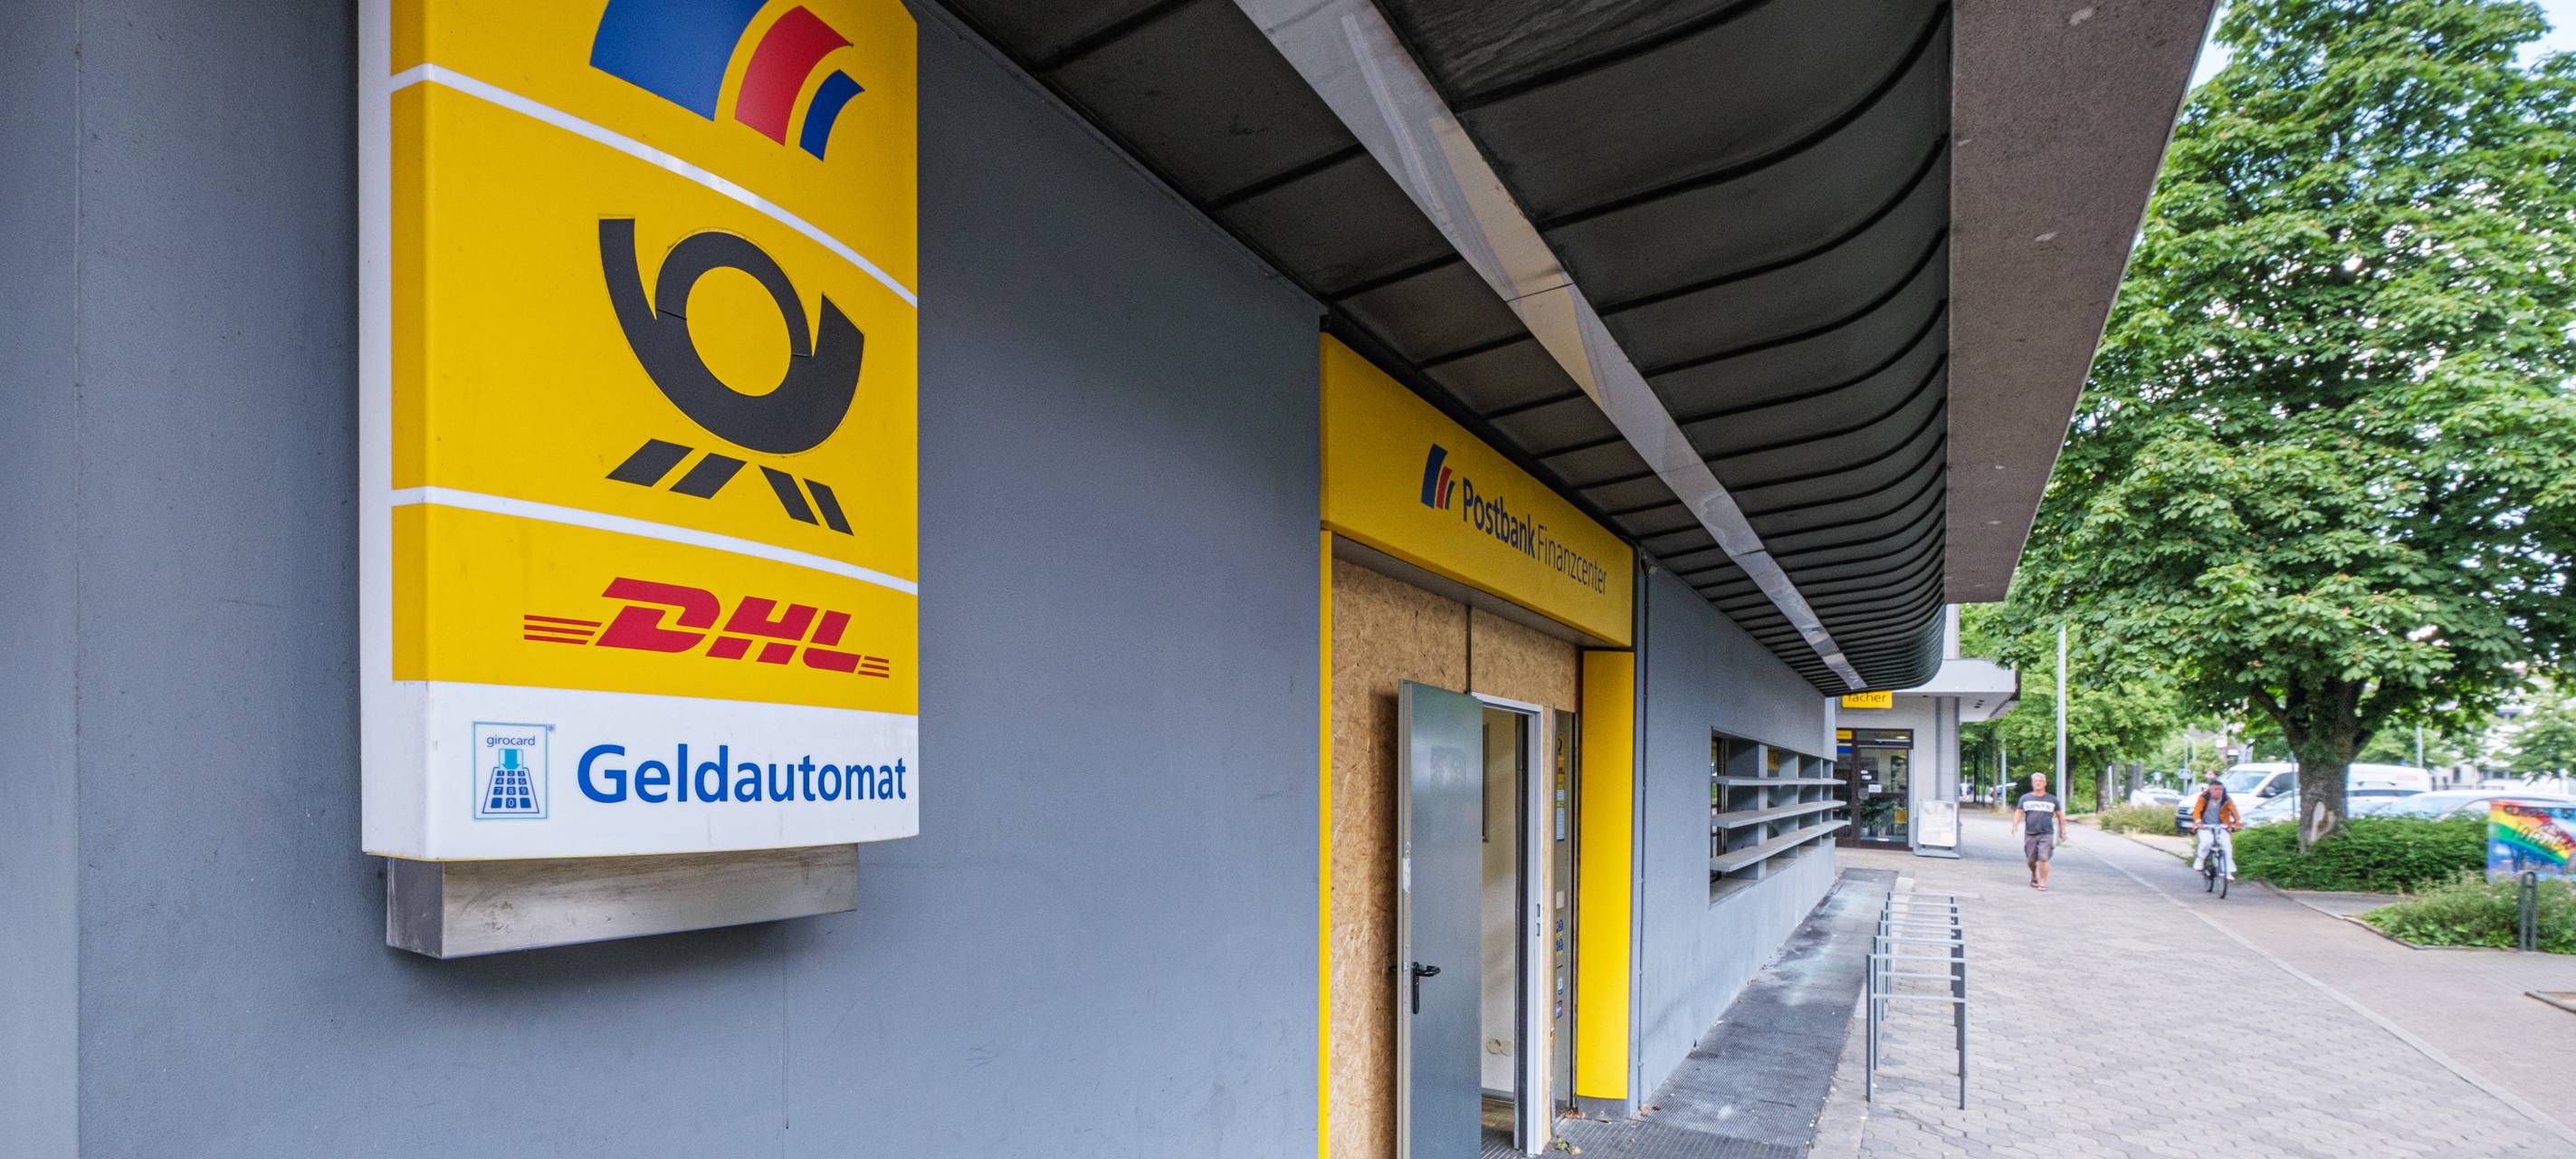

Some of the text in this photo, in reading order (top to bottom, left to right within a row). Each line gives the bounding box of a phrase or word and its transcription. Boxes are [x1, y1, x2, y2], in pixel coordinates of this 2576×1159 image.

[1463, 477, 1608, 595] Postbank Finanzcenter
[596, 577, 863, 674] DHL
[486, 734, 536, 747] girocard
[577, 743, 907, 803] Geldautomat
